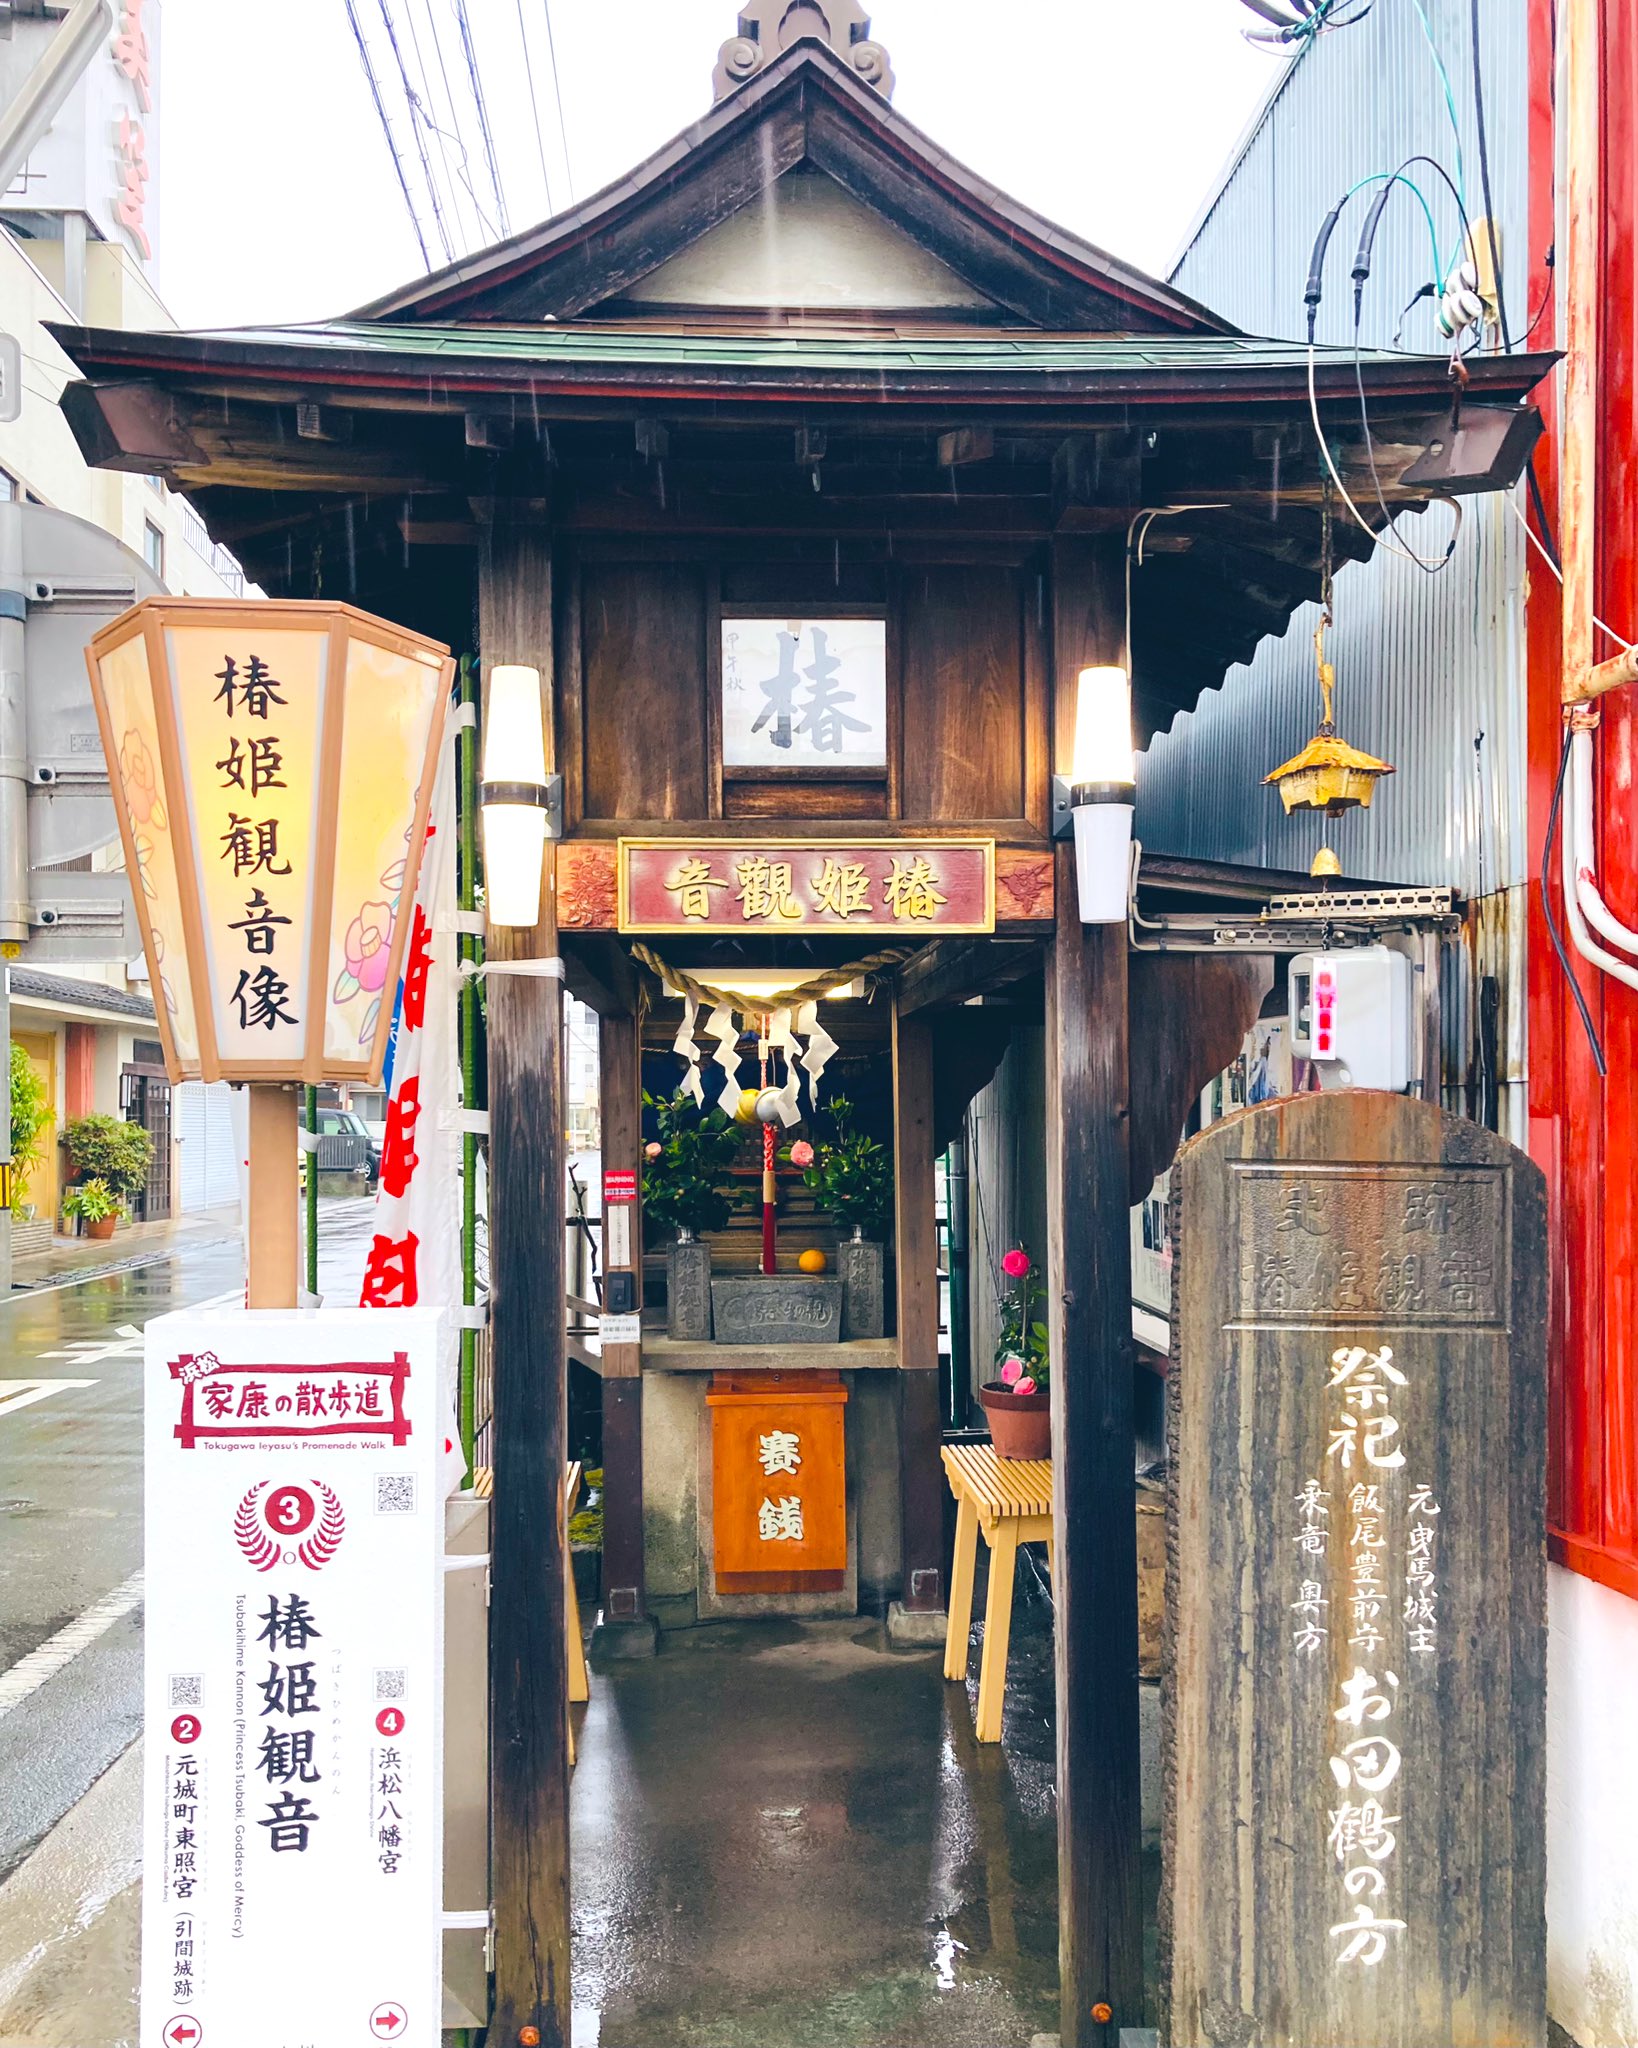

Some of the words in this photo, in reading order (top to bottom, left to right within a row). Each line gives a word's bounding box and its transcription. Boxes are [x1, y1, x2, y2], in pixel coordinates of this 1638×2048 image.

[726, 632, 746, 691] 甲午秋
[751, 627, 872, 753] 椿
[213, 654, 299, 1031] 椿姫観音像
[1276, 1179, 1463, 1235] 史跡
[1242, 1249, 1492, 1312] 椿姫観音
[178, 1352, 221, 1384] 浜松
[201, 1380, 383, 1419] 家康の散歩道
[1325, 1345, 1409, 1468] 祭祀
[204, 1441, 255, 1451] Tokugawa
[302, 1441, 358, 1449] Promenade
[361, 1441, 386, 1449] Walk
[278, 1496, 300, 1526] 3
[758, 1430, 804, 1540] 賽銭
[1293, 1478, 1331, 1554] 乗竜
[1348, 1482, 1388, 1652] 飯尾豊前守
[1404, 1484, 1441, 1652] 元曳馬城主
[236, 1594, 246, 1667] Tsubakihime
[1290, 1579, 1329, 1651] 奥方
[235, 1671, 246, 1716] Kannon
[255, 1593, 323, 1852] 椿姫観音
[234, 1718, 246, 1770] (Princess
[234, 1775, 245, 1821] Tsubaki,
[378, 1746, 402, 1874] 浜松八幡宮
[1329, 1666, 1407, 1966] お田鶴の方
[234, 1825, 245, 1877] Goddess
[232, 1895, 244, 1938] Mercy)
[235, 1881, 244, 1892] of
